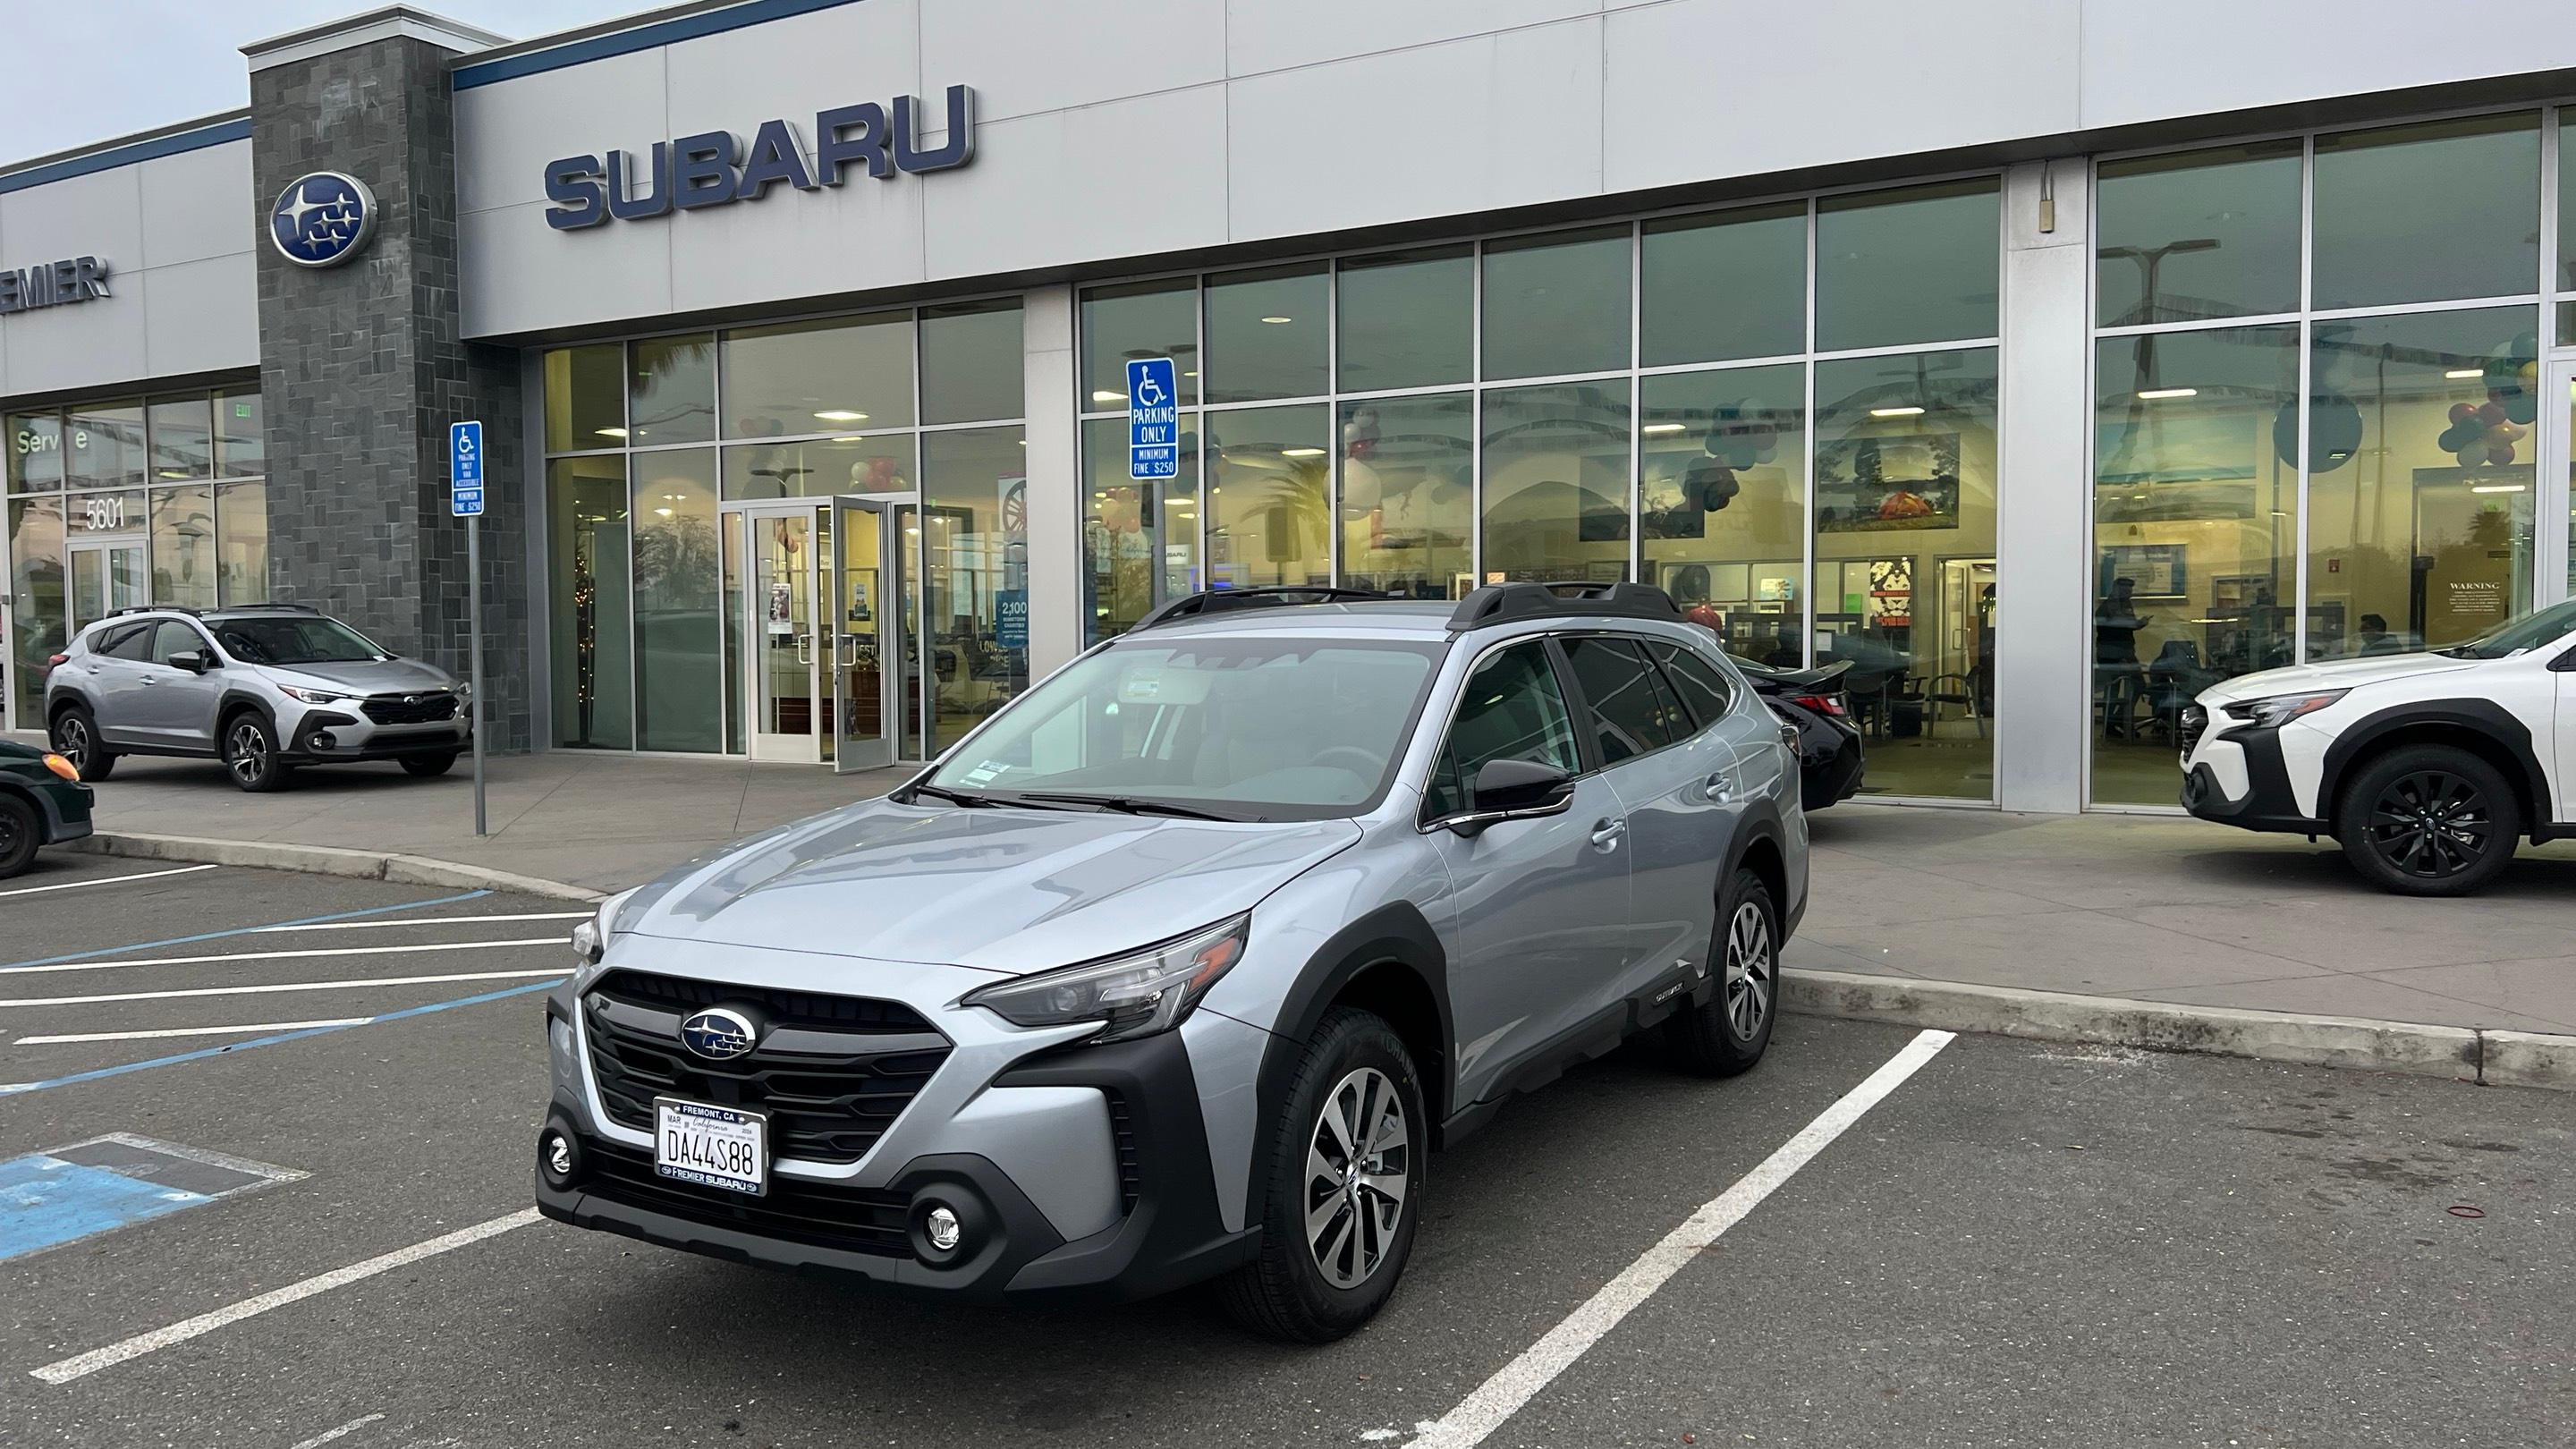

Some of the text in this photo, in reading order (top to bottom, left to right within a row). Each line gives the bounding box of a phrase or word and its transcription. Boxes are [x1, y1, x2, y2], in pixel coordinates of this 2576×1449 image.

[544, 84, 975, 231] SUBARU
[1133, 407, 1174, 425] PARKING
[17, 430, 88, 453] Serve
[1141, 427, 1166, 443] ONLY
[1139, 449, 1169, 461] MINIMUM
[462, 462, 472, 470] ONLY
[1133, 462, 1174, 474] FINE $250
[87, 496, 123, 530] 5601
[455, 502, 481, 512] FINE $250
[1002, 602, 1027, 616] 2,100
[683, 1106, 735, 1122] FREMONT, CA
[667, 1114, 682, 1124] MAR
[692, 1117, 728, 1132] California
[668, 1130, 753, 1175] DA44S88
[672, 1167, 746, 1191] PREMIER SUBARU
